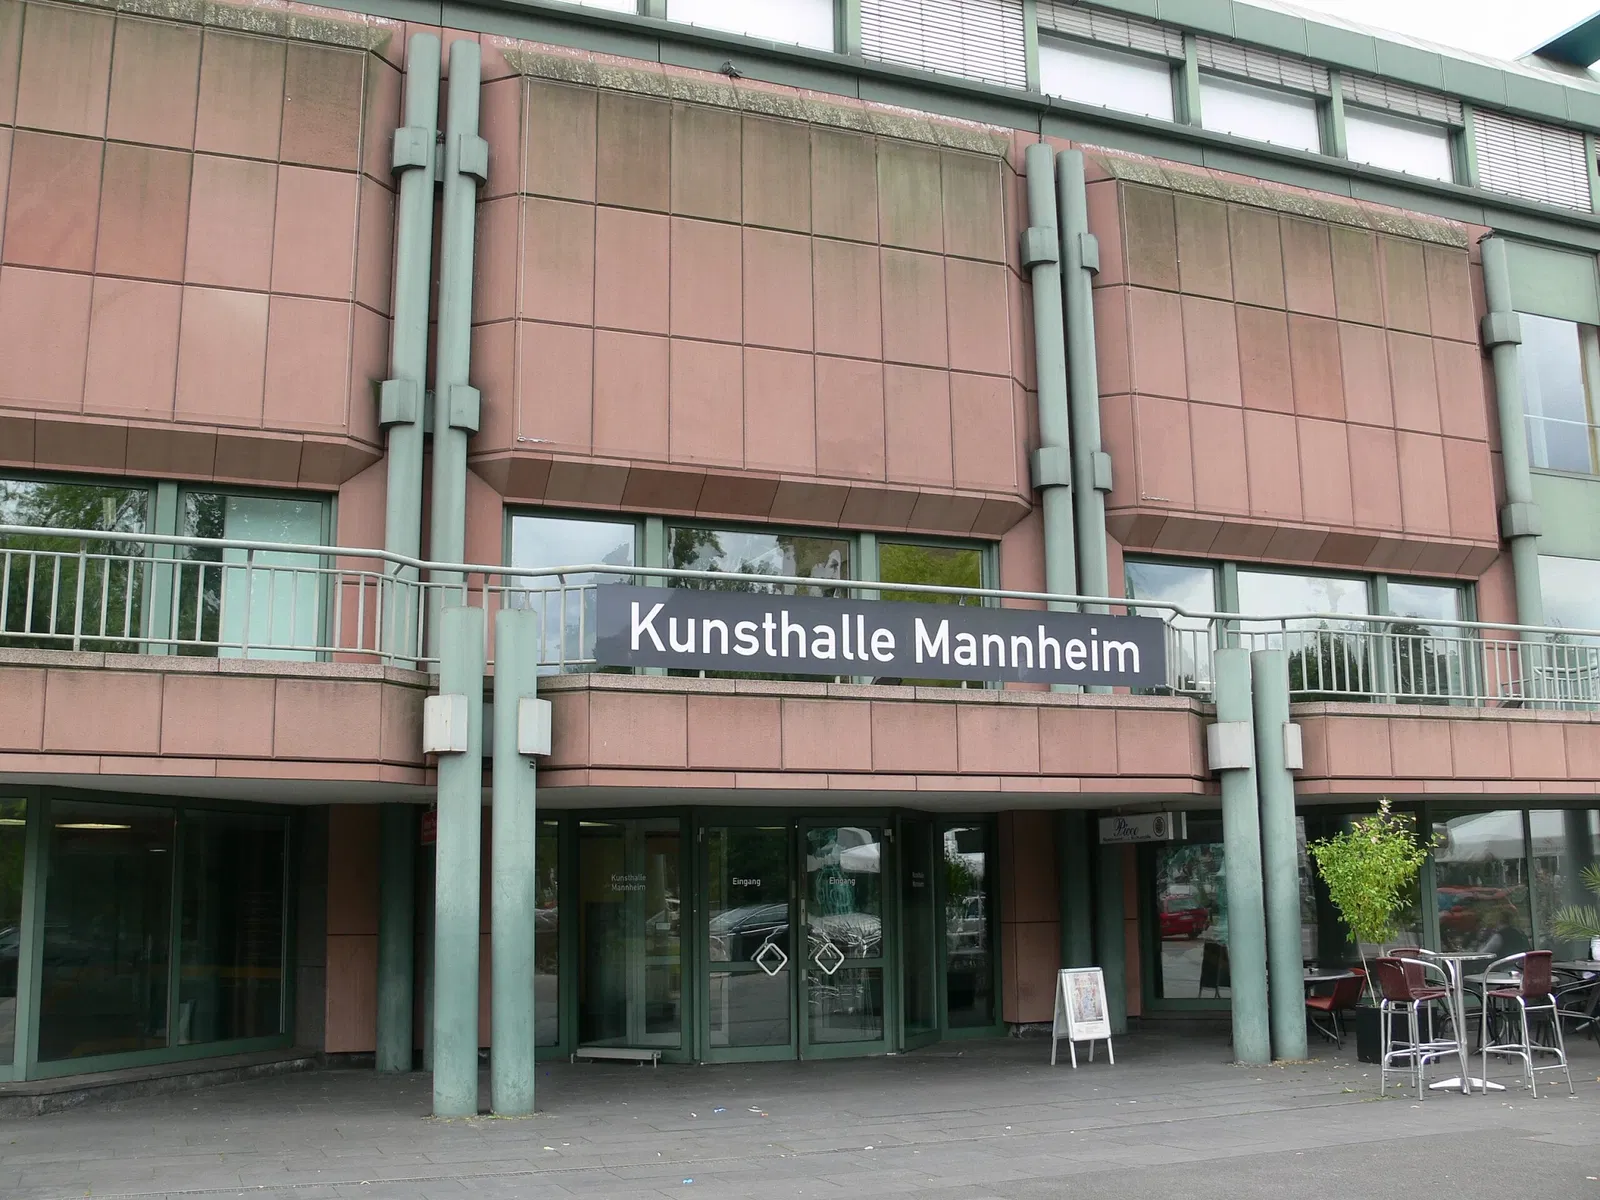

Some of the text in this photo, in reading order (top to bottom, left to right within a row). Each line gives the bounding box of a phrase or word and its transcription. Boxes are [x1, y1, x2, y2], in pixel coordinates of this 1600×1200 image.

[629, 600, 1140, 674] Kunsthalle Mannheim
[611, 873, 647, 882] Kunsthalle
[732, 877, 761, 887] Eingang
[829, 876, 856, 887] Eingang
[611, 883, 646, 892] Mannheim
